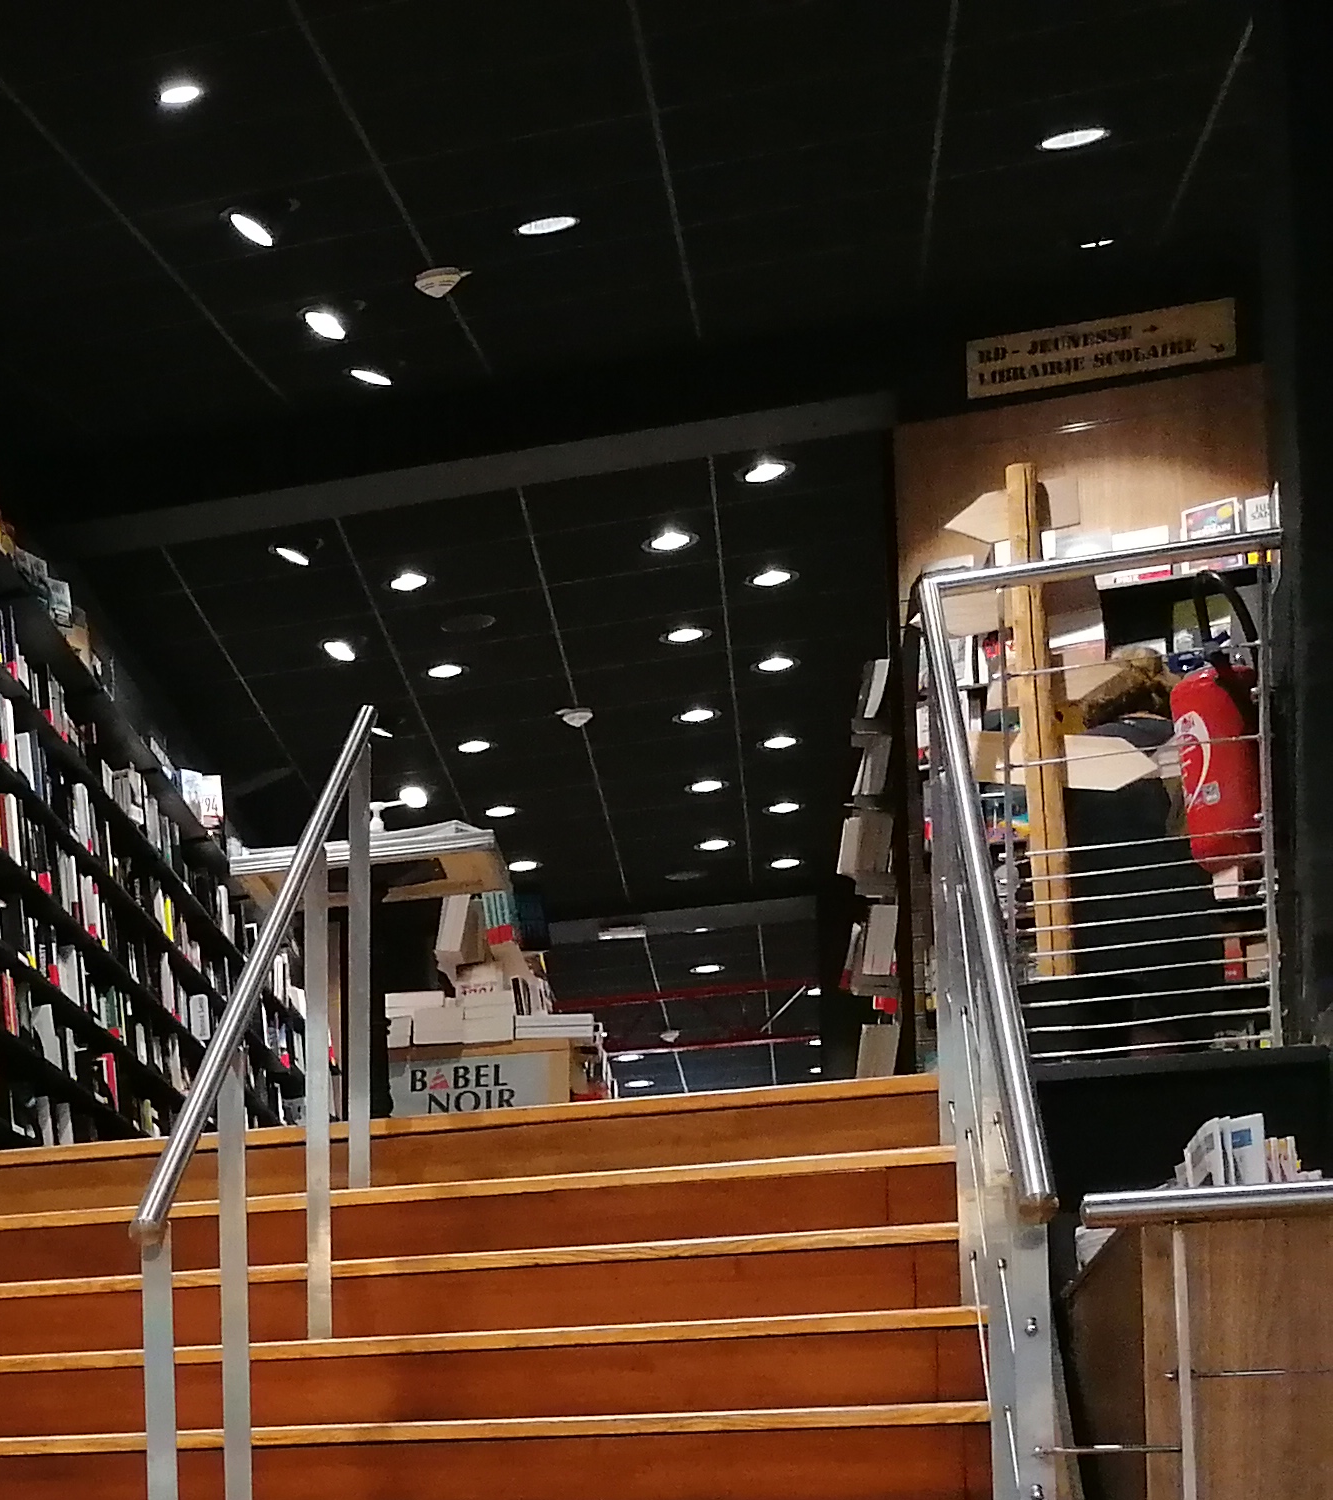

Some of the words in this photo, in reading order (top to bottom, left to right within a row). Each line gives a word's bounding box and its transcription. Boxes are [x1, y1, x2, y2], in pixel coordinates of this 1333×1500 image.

[1027, 324, 1133, 356] JEUNESSE
[978, 356, 1086, 386] LIBRAIRIE
[1092, 338, 1199, 370] SCOLAIRE
[427, 1088, 517, 1115] NOIR
